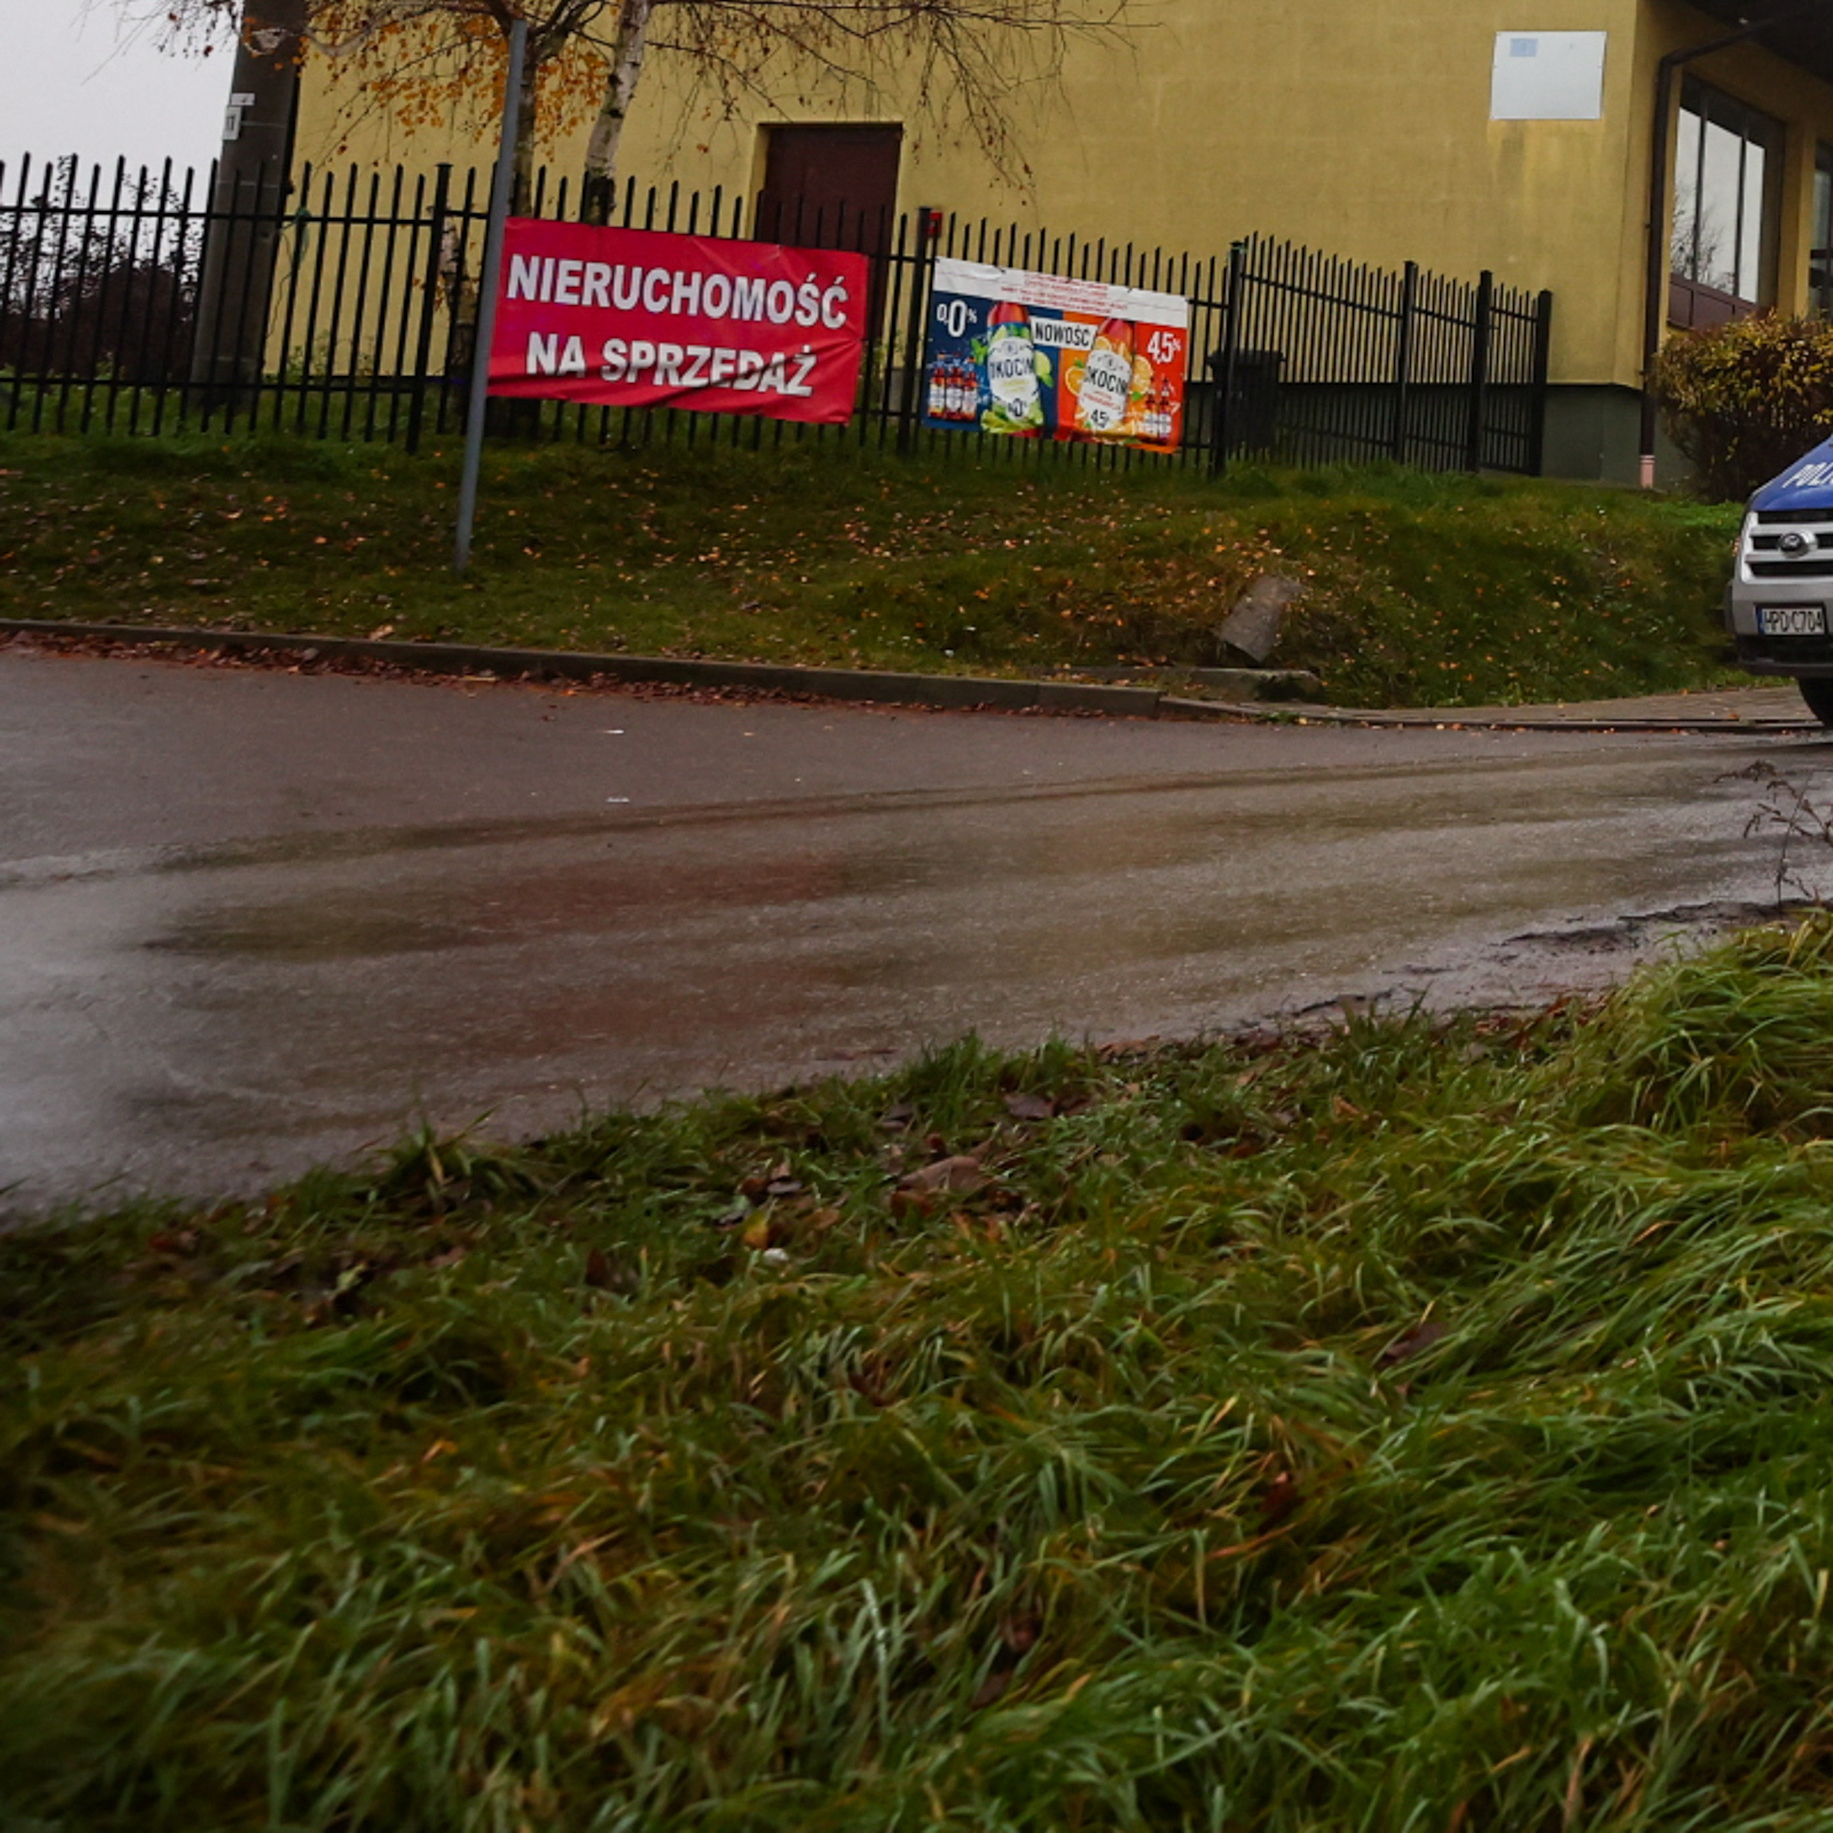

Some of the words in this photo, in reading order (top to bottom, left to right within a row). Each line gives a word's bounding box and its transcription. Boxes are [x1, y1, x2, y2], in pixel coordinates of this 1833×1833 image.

[507, 254, 848, 329] NIERUCHOMOŚĆ
[526, 331, 585, 378] NA
[602, 338, 817, 397] SPRZEDAŻ
